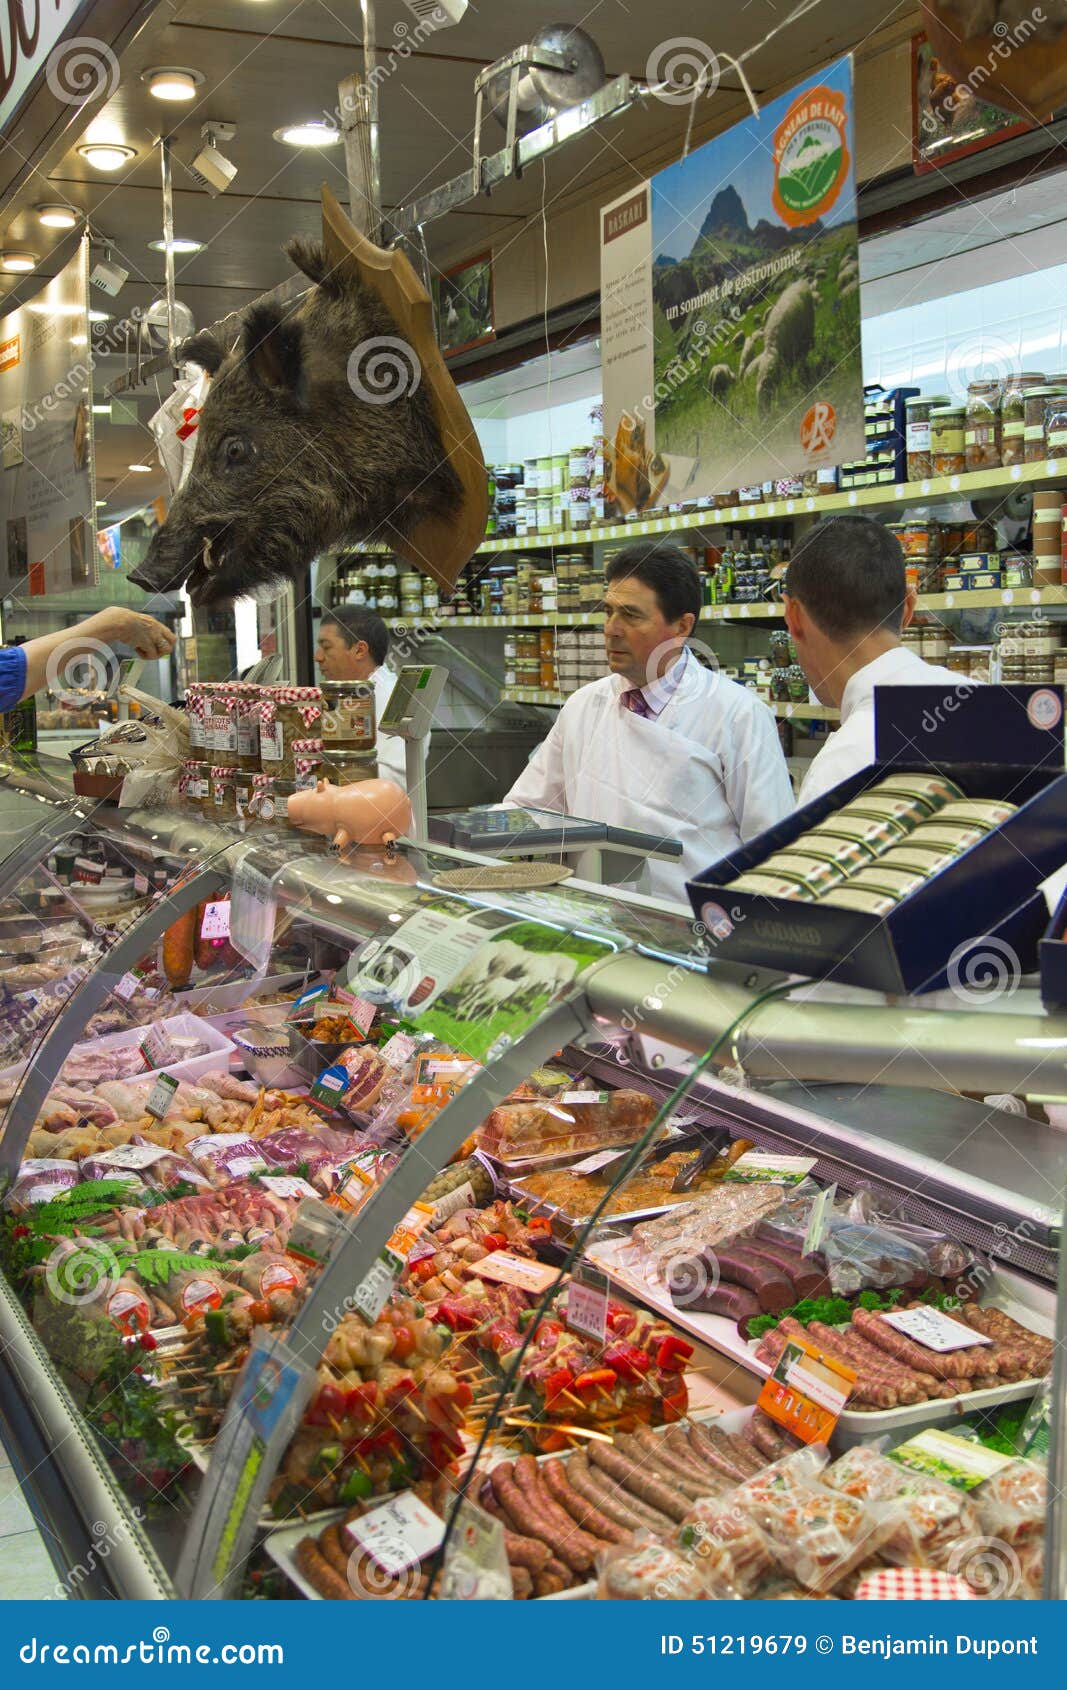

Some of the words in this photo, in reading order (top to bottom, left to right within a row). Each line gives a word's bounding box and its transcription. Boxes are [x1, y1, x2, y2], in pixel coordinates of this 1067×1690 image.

[775, 106, 808, 162] AGNEAU
[810, 101, 823, 118] DE
[823, 103, 846, 127] LAIT
[666, 304, 680, 320] un
[680, 284, 720, 316] sommet
[721, 278, 734, 298] de
[734, 249, 802, 295] gastronomie
